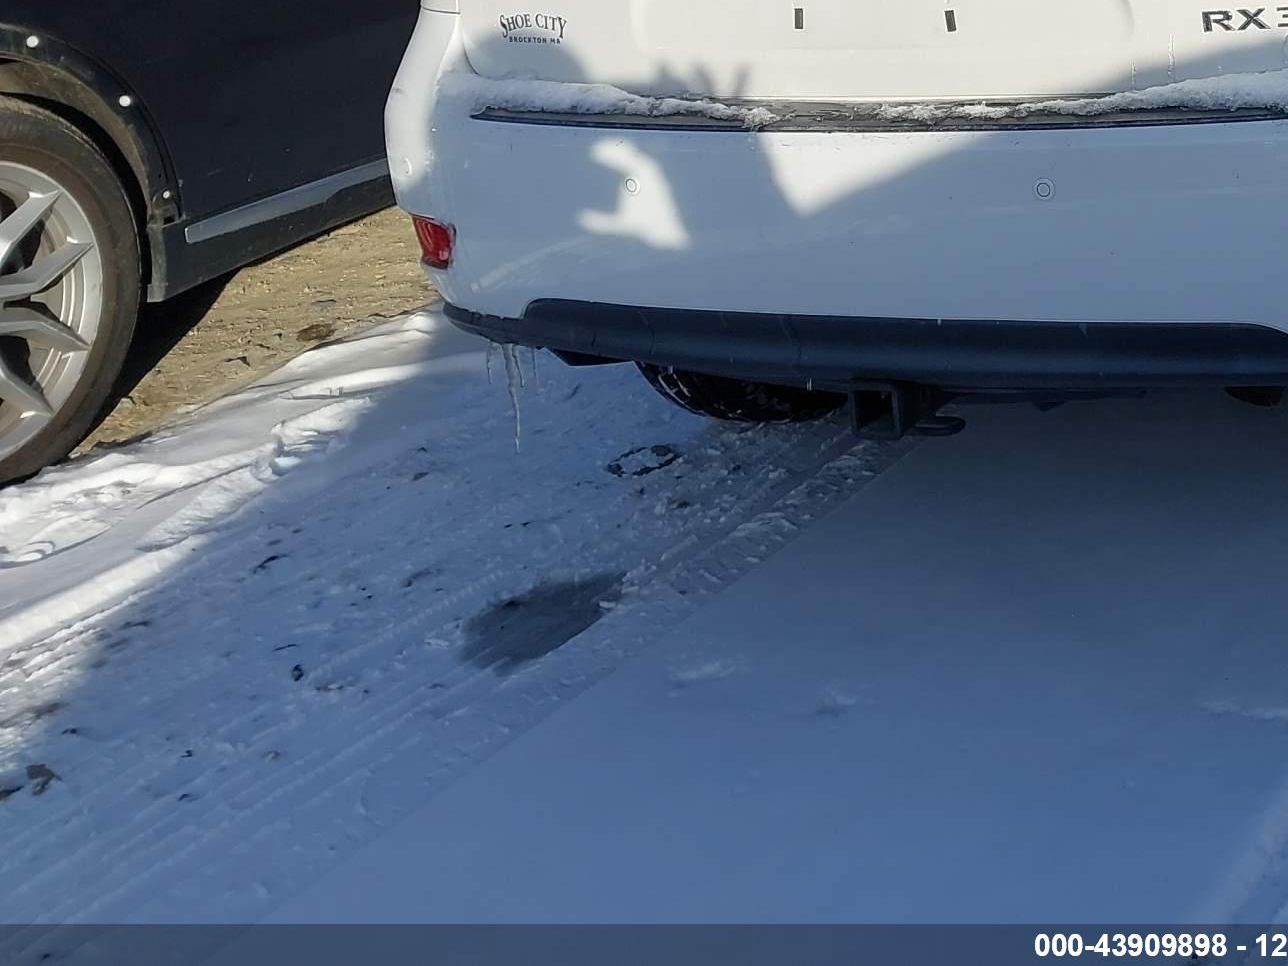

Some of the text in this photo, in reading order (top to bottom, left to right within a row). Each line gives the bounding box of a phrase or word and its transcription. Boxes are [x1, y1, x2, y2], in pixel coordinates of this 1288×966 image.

[500, 13, 567, 39] SHOE CITY
[1202, 8, 1271, 32] RX
